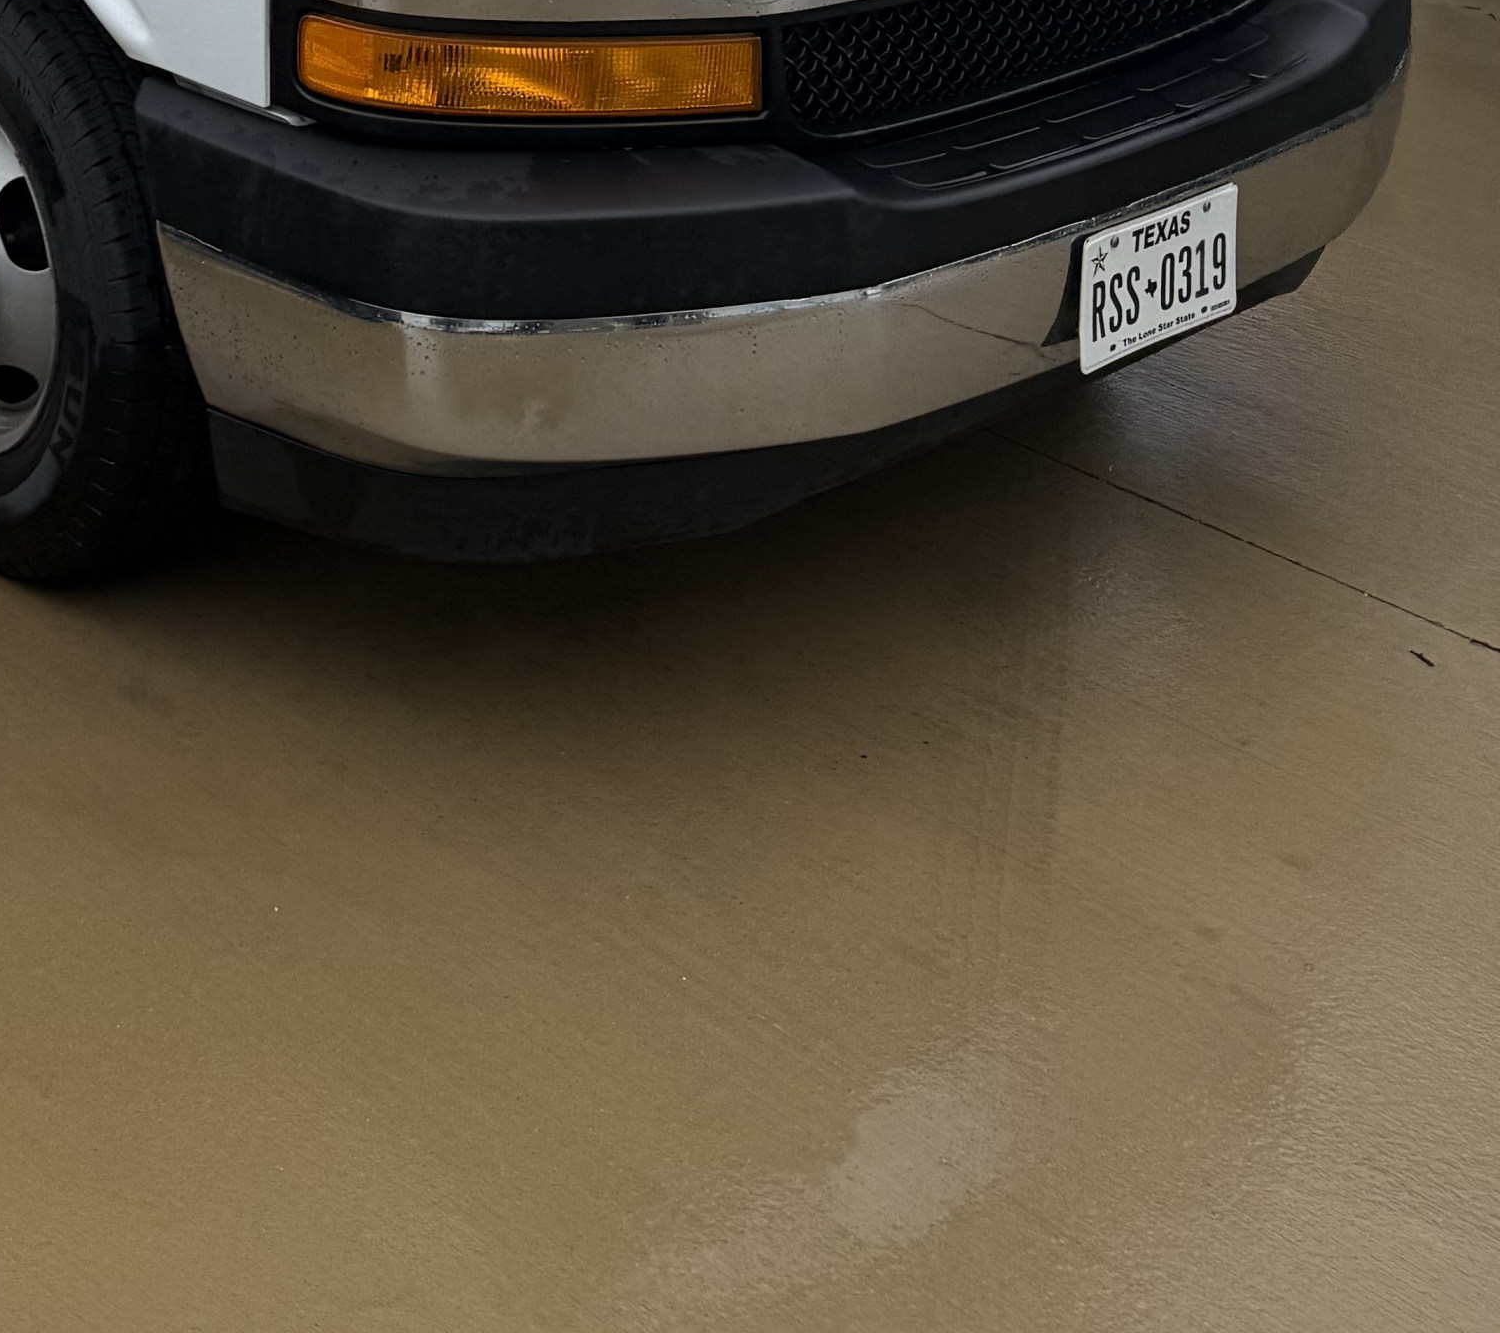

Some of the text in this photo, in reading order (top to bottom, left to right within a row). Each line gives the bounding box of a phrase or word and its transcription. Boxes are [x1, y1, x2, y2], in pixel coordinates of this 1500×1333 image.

[1132, 210, 1191, 253] TEXAS
[1122, 312, 1196, 347] The Lone Star State
